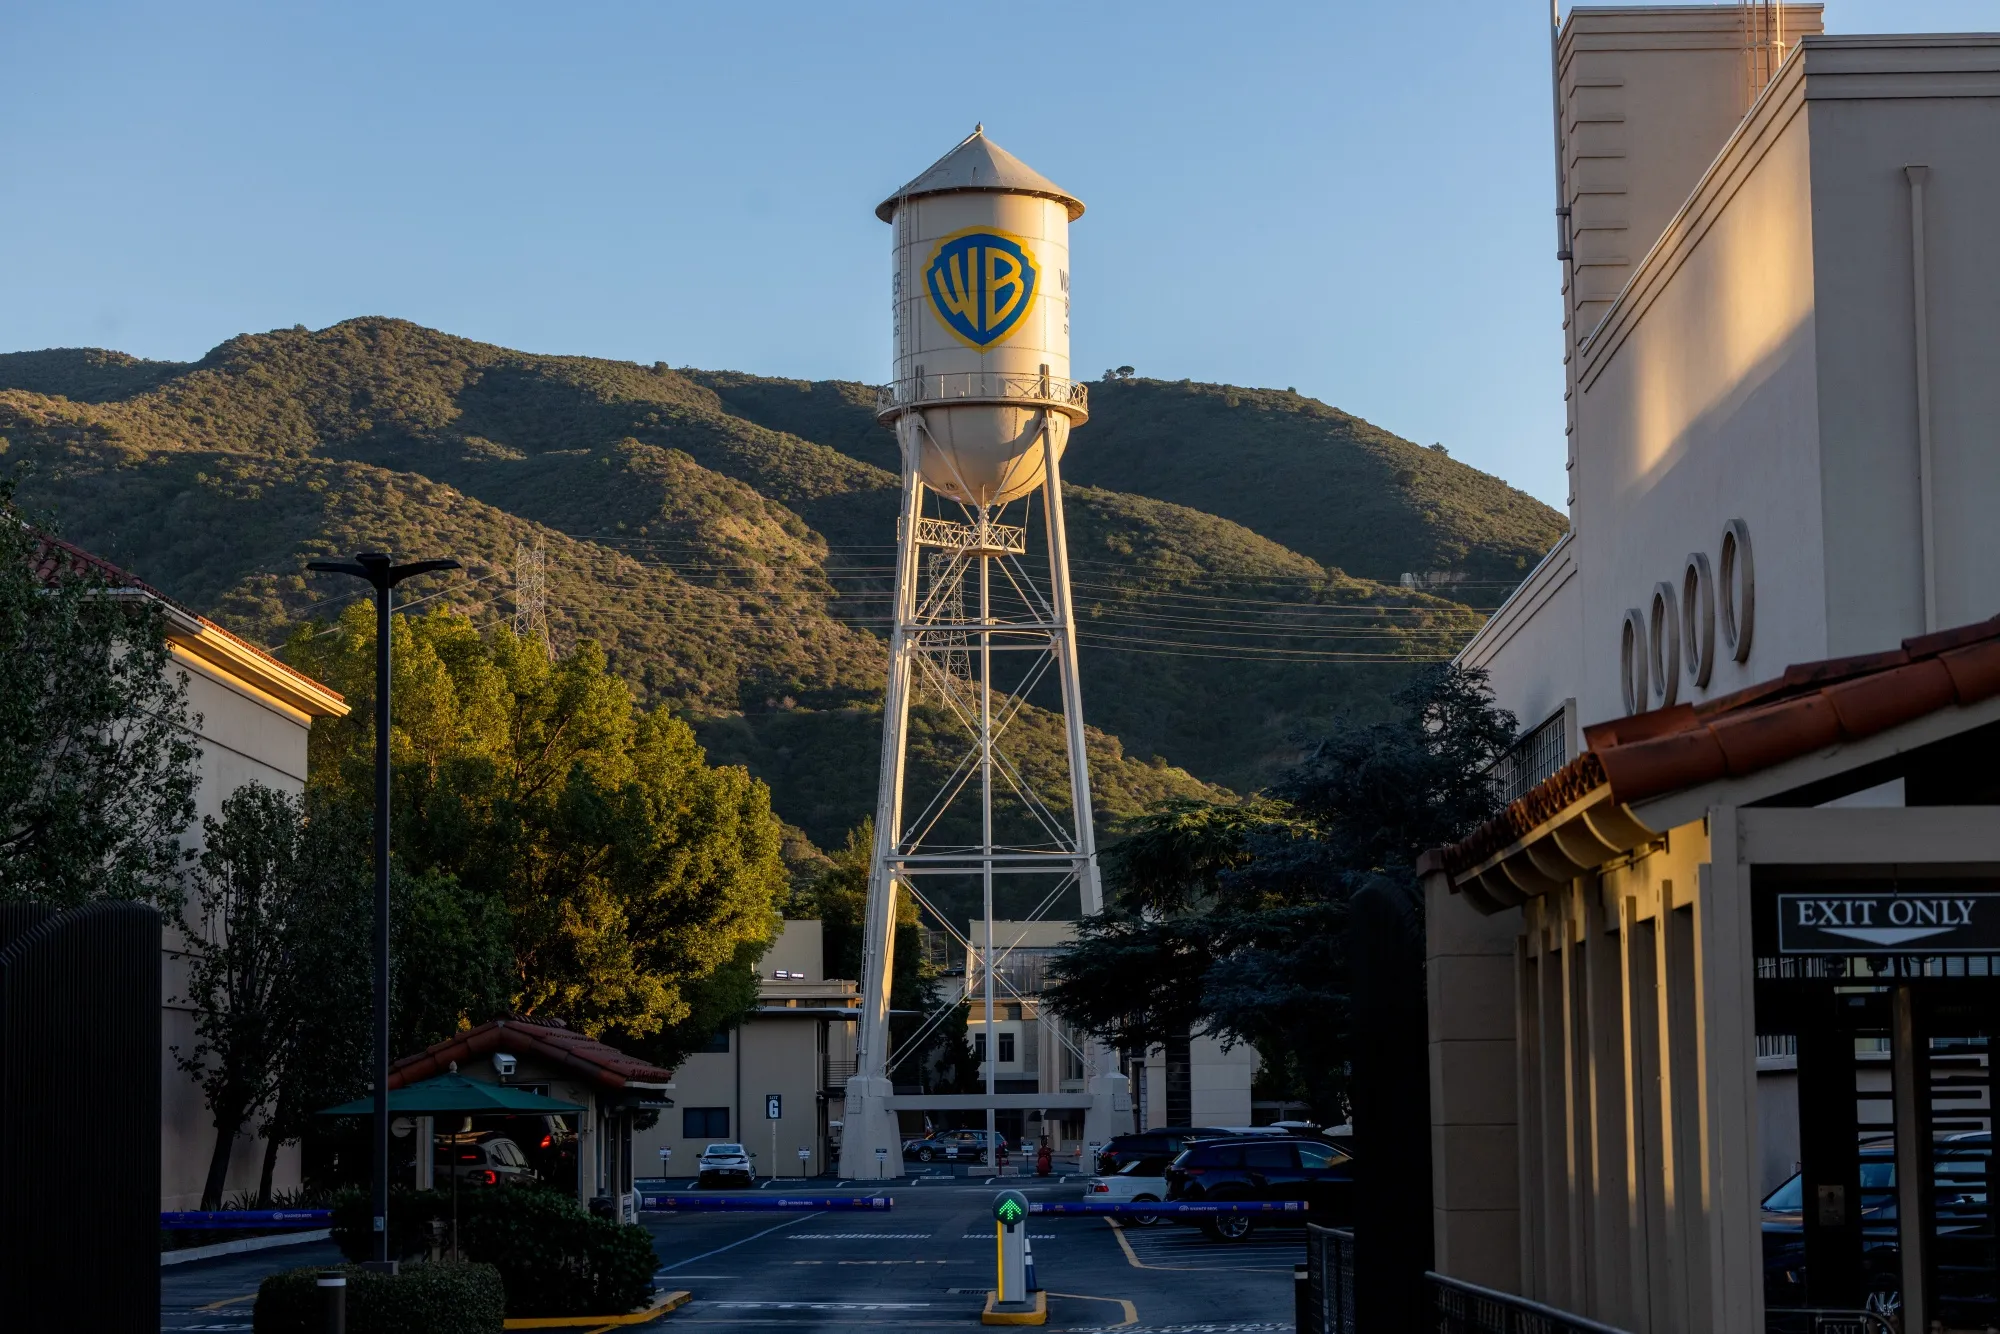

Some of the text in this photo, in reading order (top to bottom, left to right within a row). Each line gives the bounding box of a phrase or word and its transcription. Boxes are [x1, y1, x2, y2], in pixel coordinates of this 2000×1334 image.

[934, 246, 1025, 333] WB
[1796, 899, 1977, 926] EXIT ONLY
[768, 1099, 779, 1118] G
[1824, 1324, 1858, 1334] EXIT
